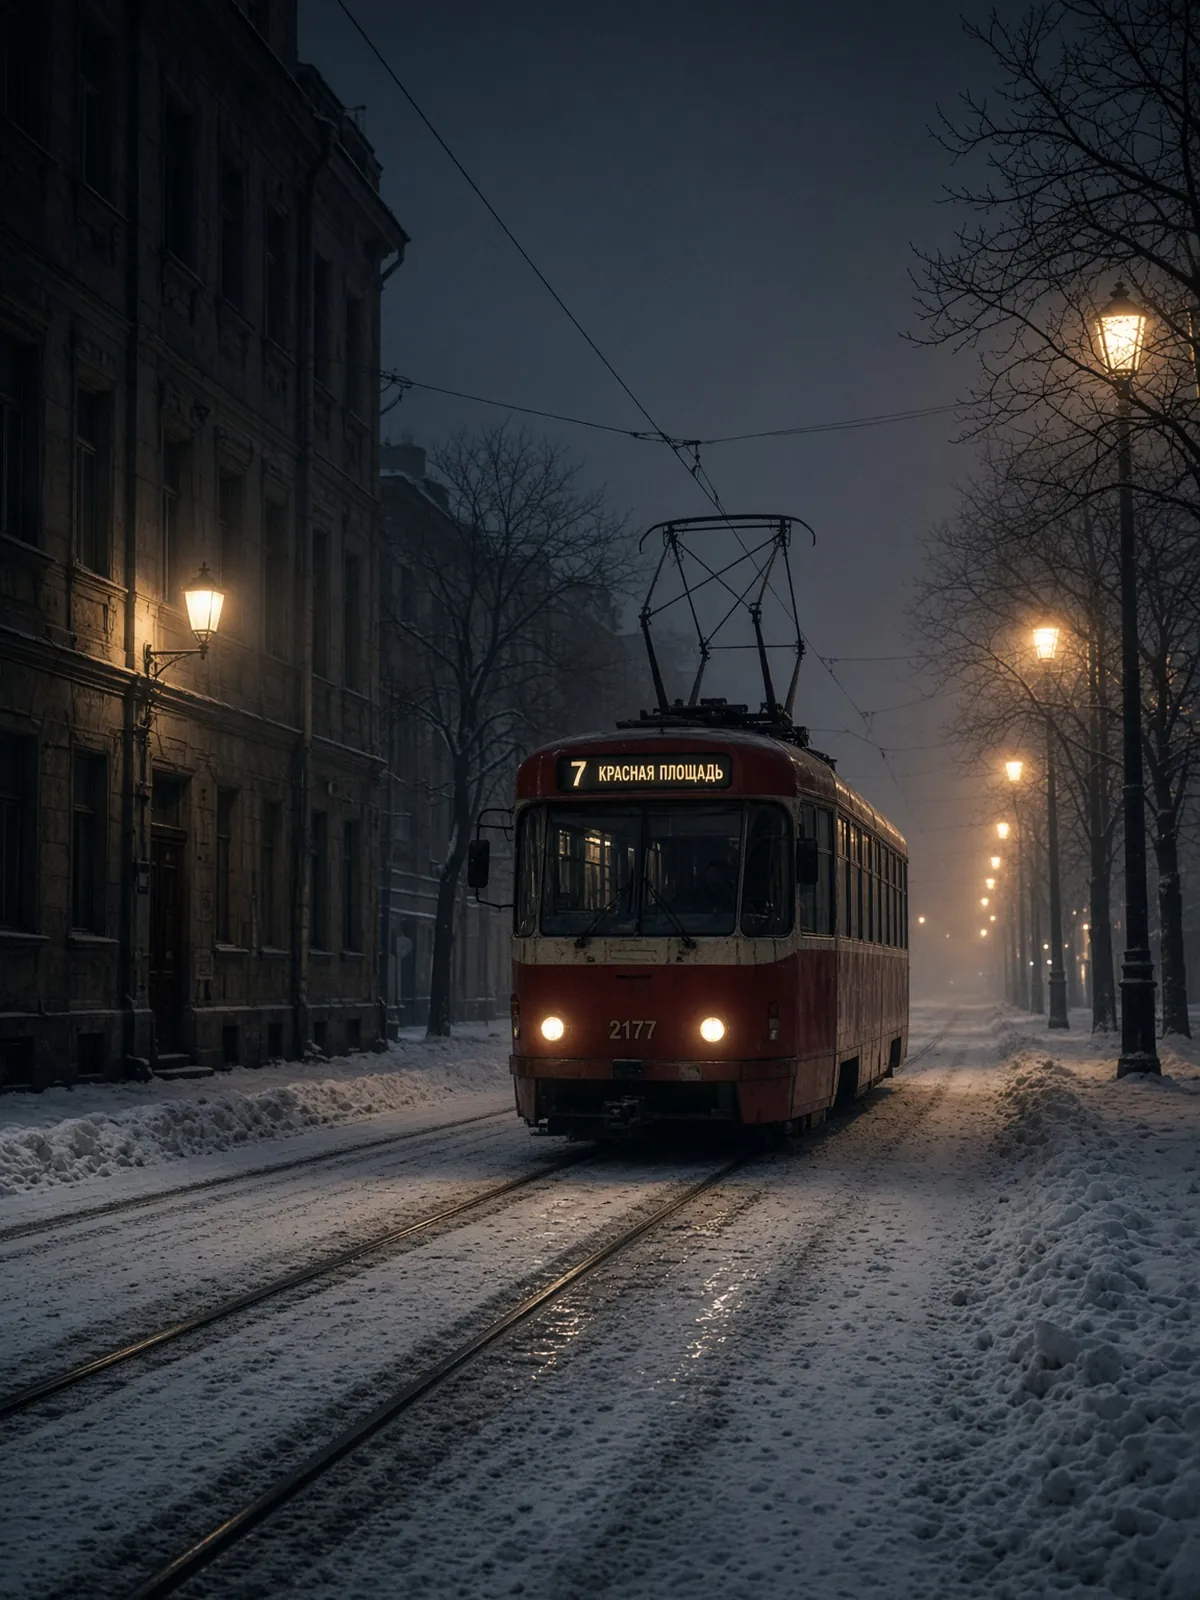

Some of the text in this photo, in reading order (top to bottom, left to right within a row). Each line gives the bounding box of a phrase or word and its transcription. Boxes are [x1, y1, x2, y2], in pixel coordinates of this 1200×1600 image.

[571, 761, 724, 787] 7 КРАСНАЯ ПЛОЩАДЬ
[609, 1020, 657, 1040] 2177
